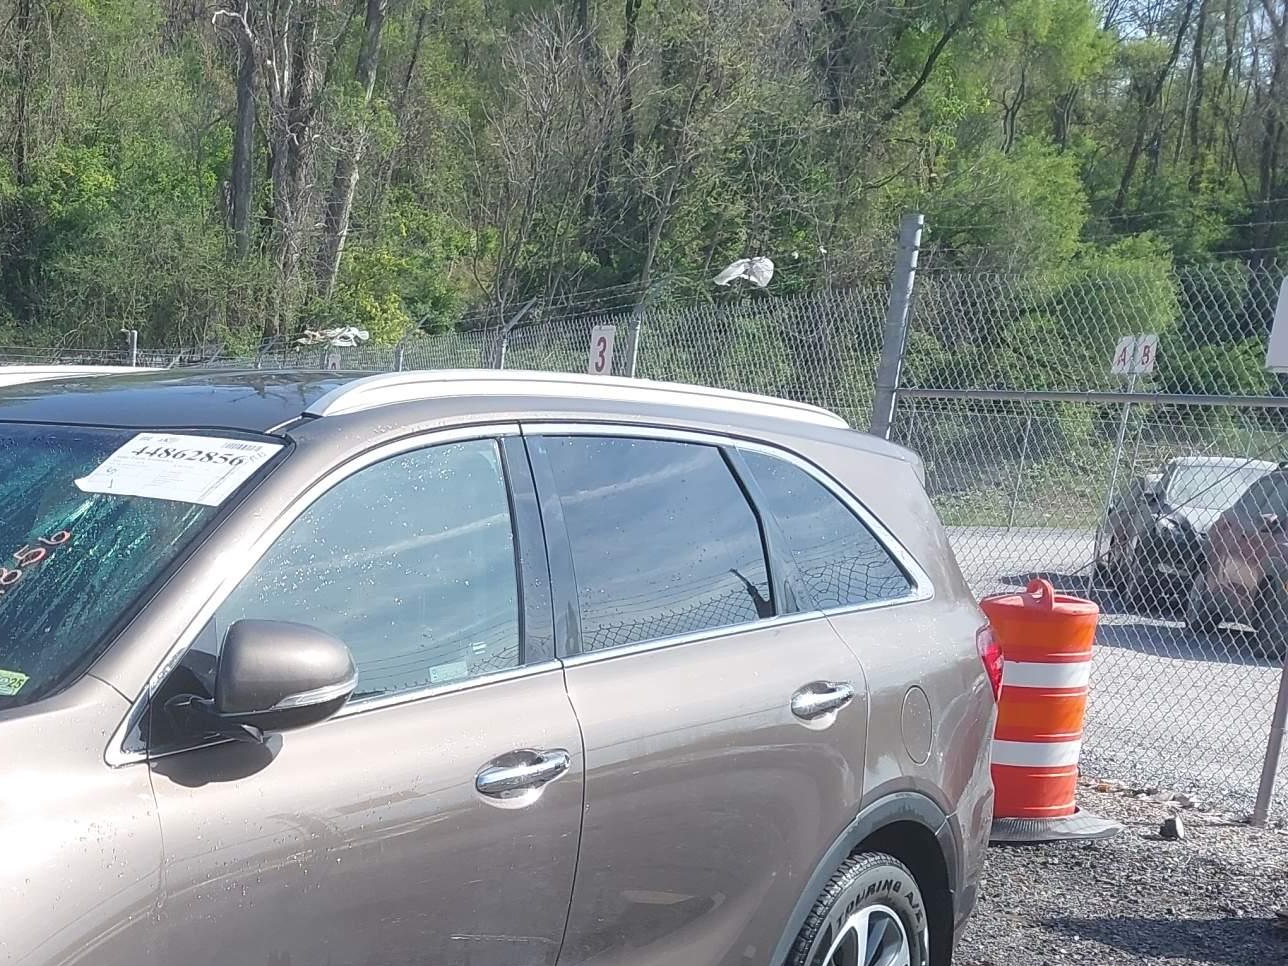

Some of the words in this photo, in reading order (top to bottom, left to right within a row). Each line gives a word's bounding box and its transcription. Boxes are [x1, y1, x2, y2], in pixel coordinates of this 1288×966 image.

[594, 336, 608, 373] 3
[1116, 346, 1128, 367] A
[1140, 344, 1151, 366] B
[129, 444, 246, 467] 44862856
[7, 677, 24, 690] 25
[837, 880, 903, 929] TOURING
